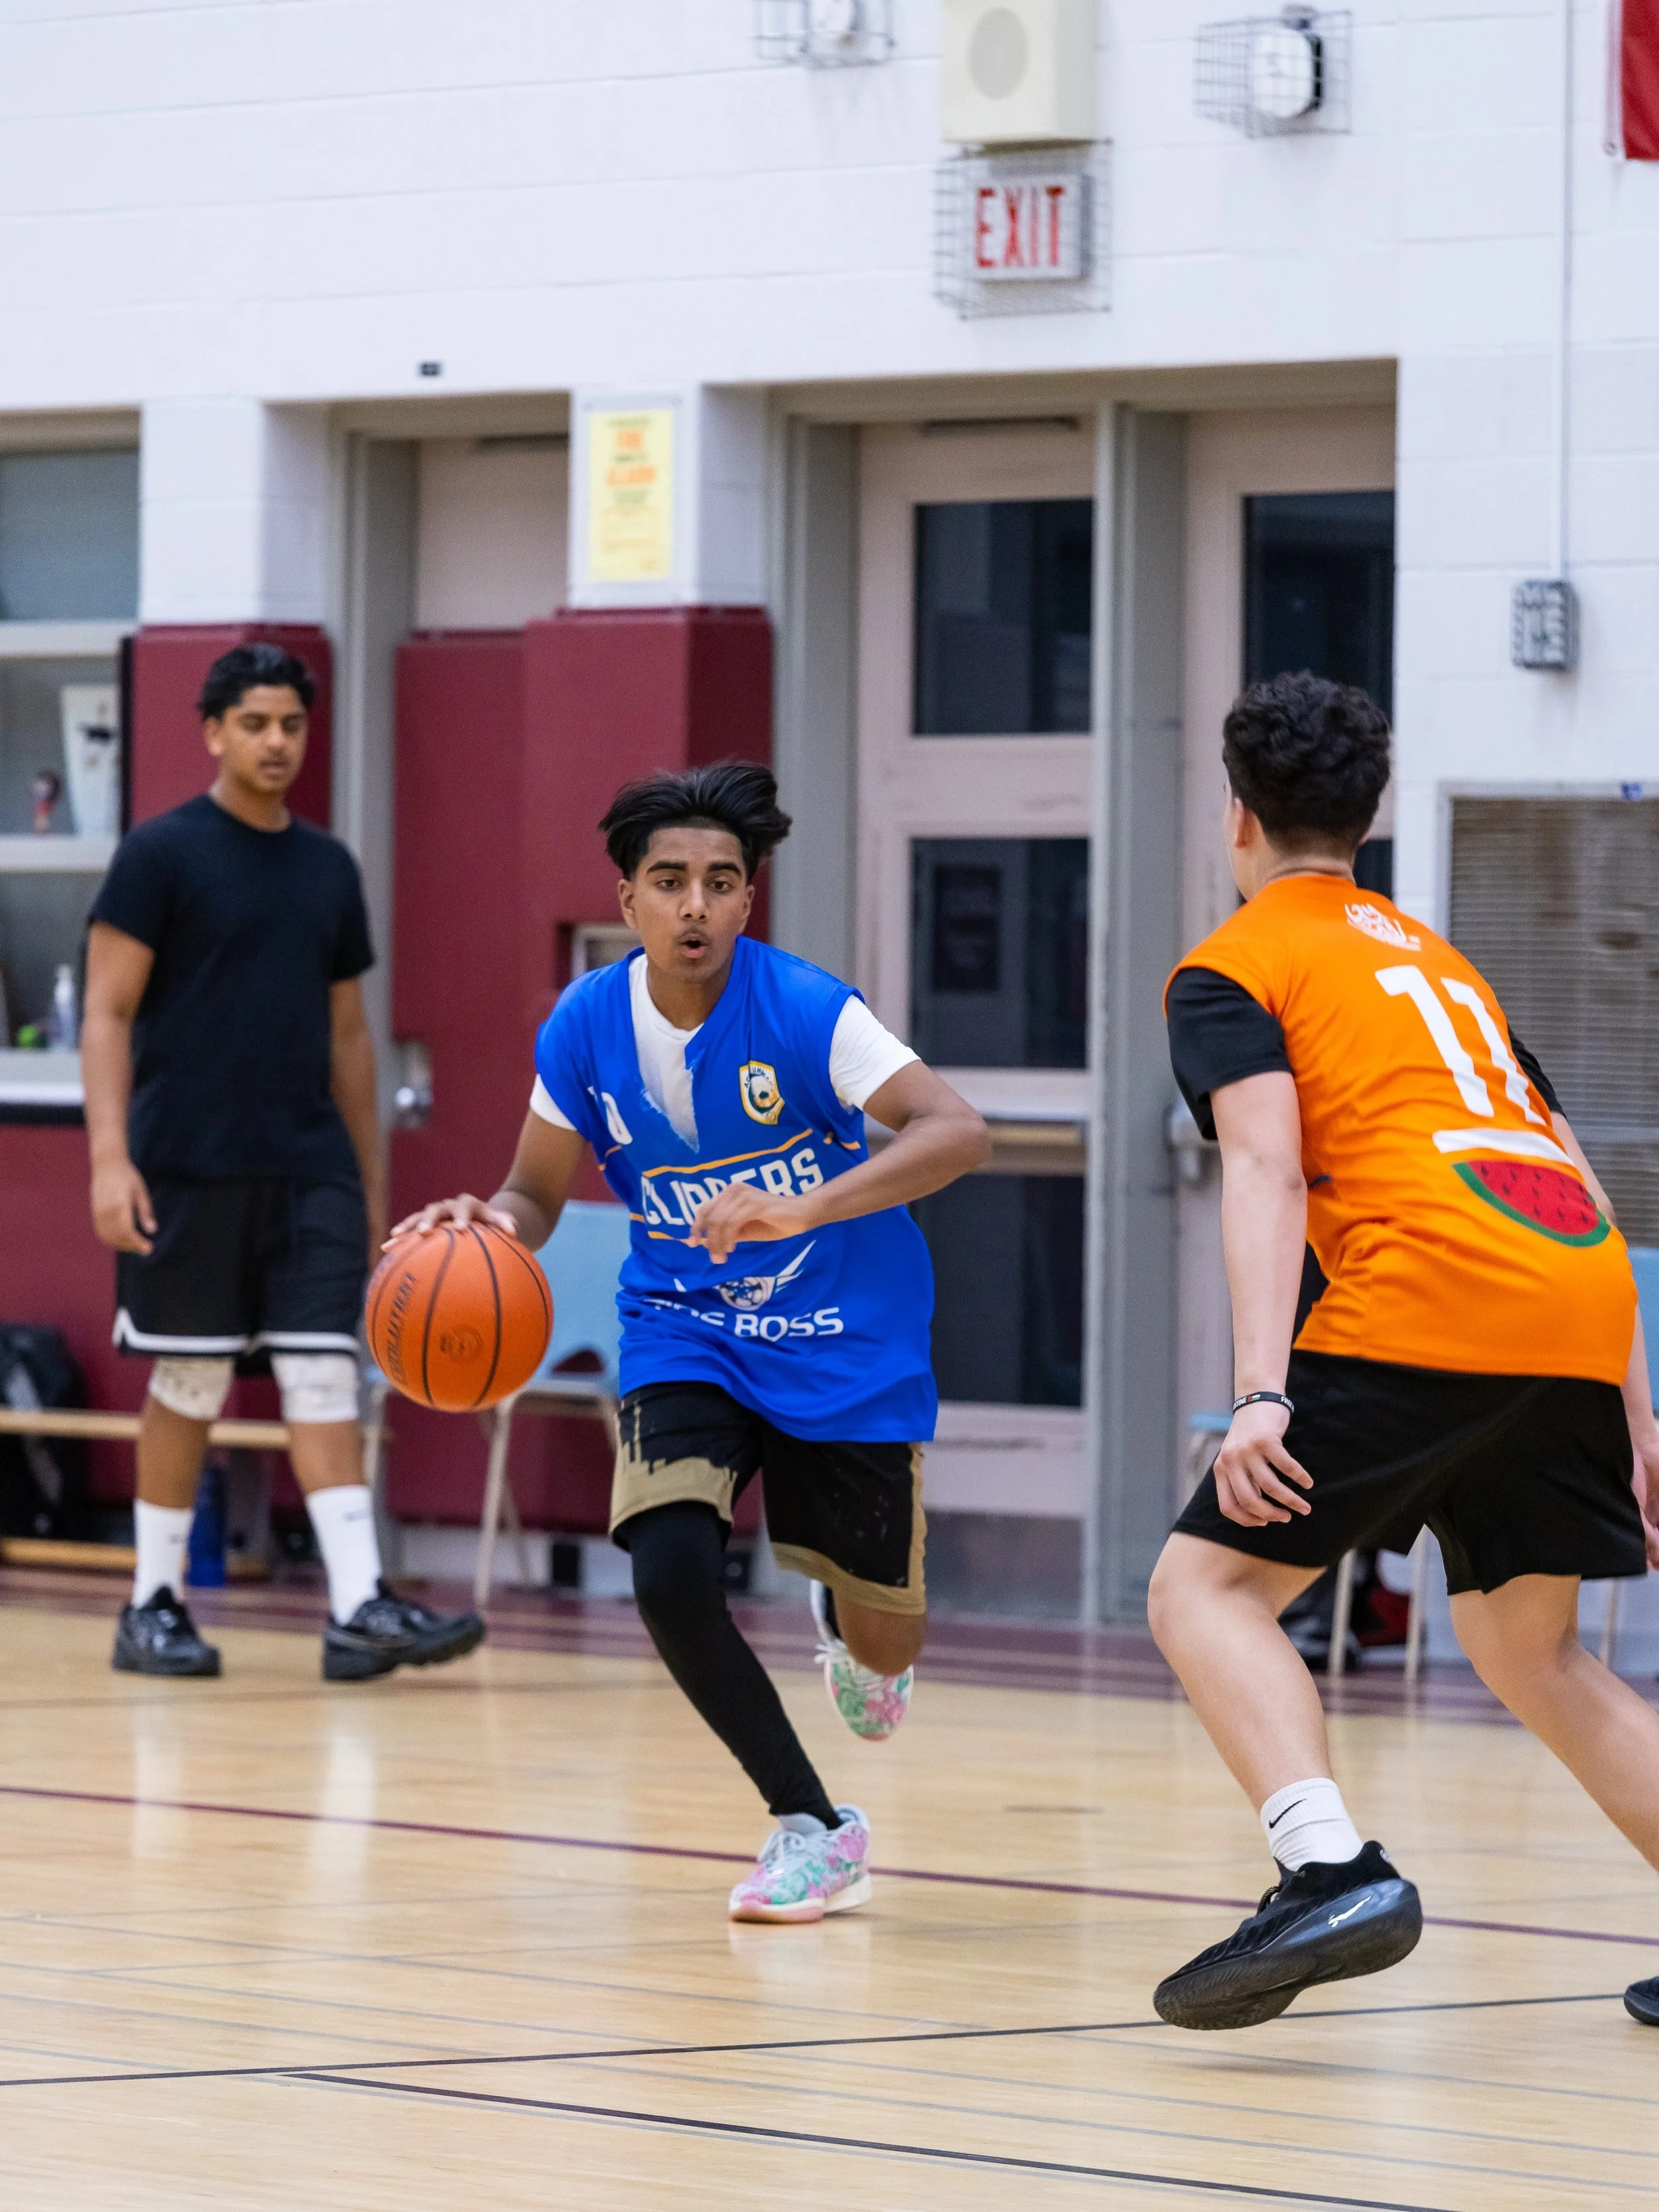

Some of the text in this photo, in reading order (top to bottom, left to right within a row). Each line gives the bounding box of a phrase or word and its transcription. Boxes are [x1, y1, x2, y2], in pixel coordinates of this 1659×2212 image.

[974, 185, 1066, 268] EXIT
[641, 1148, 824, 1226] CLIPRS
[734, 1307, 844, 1342] BOSS
